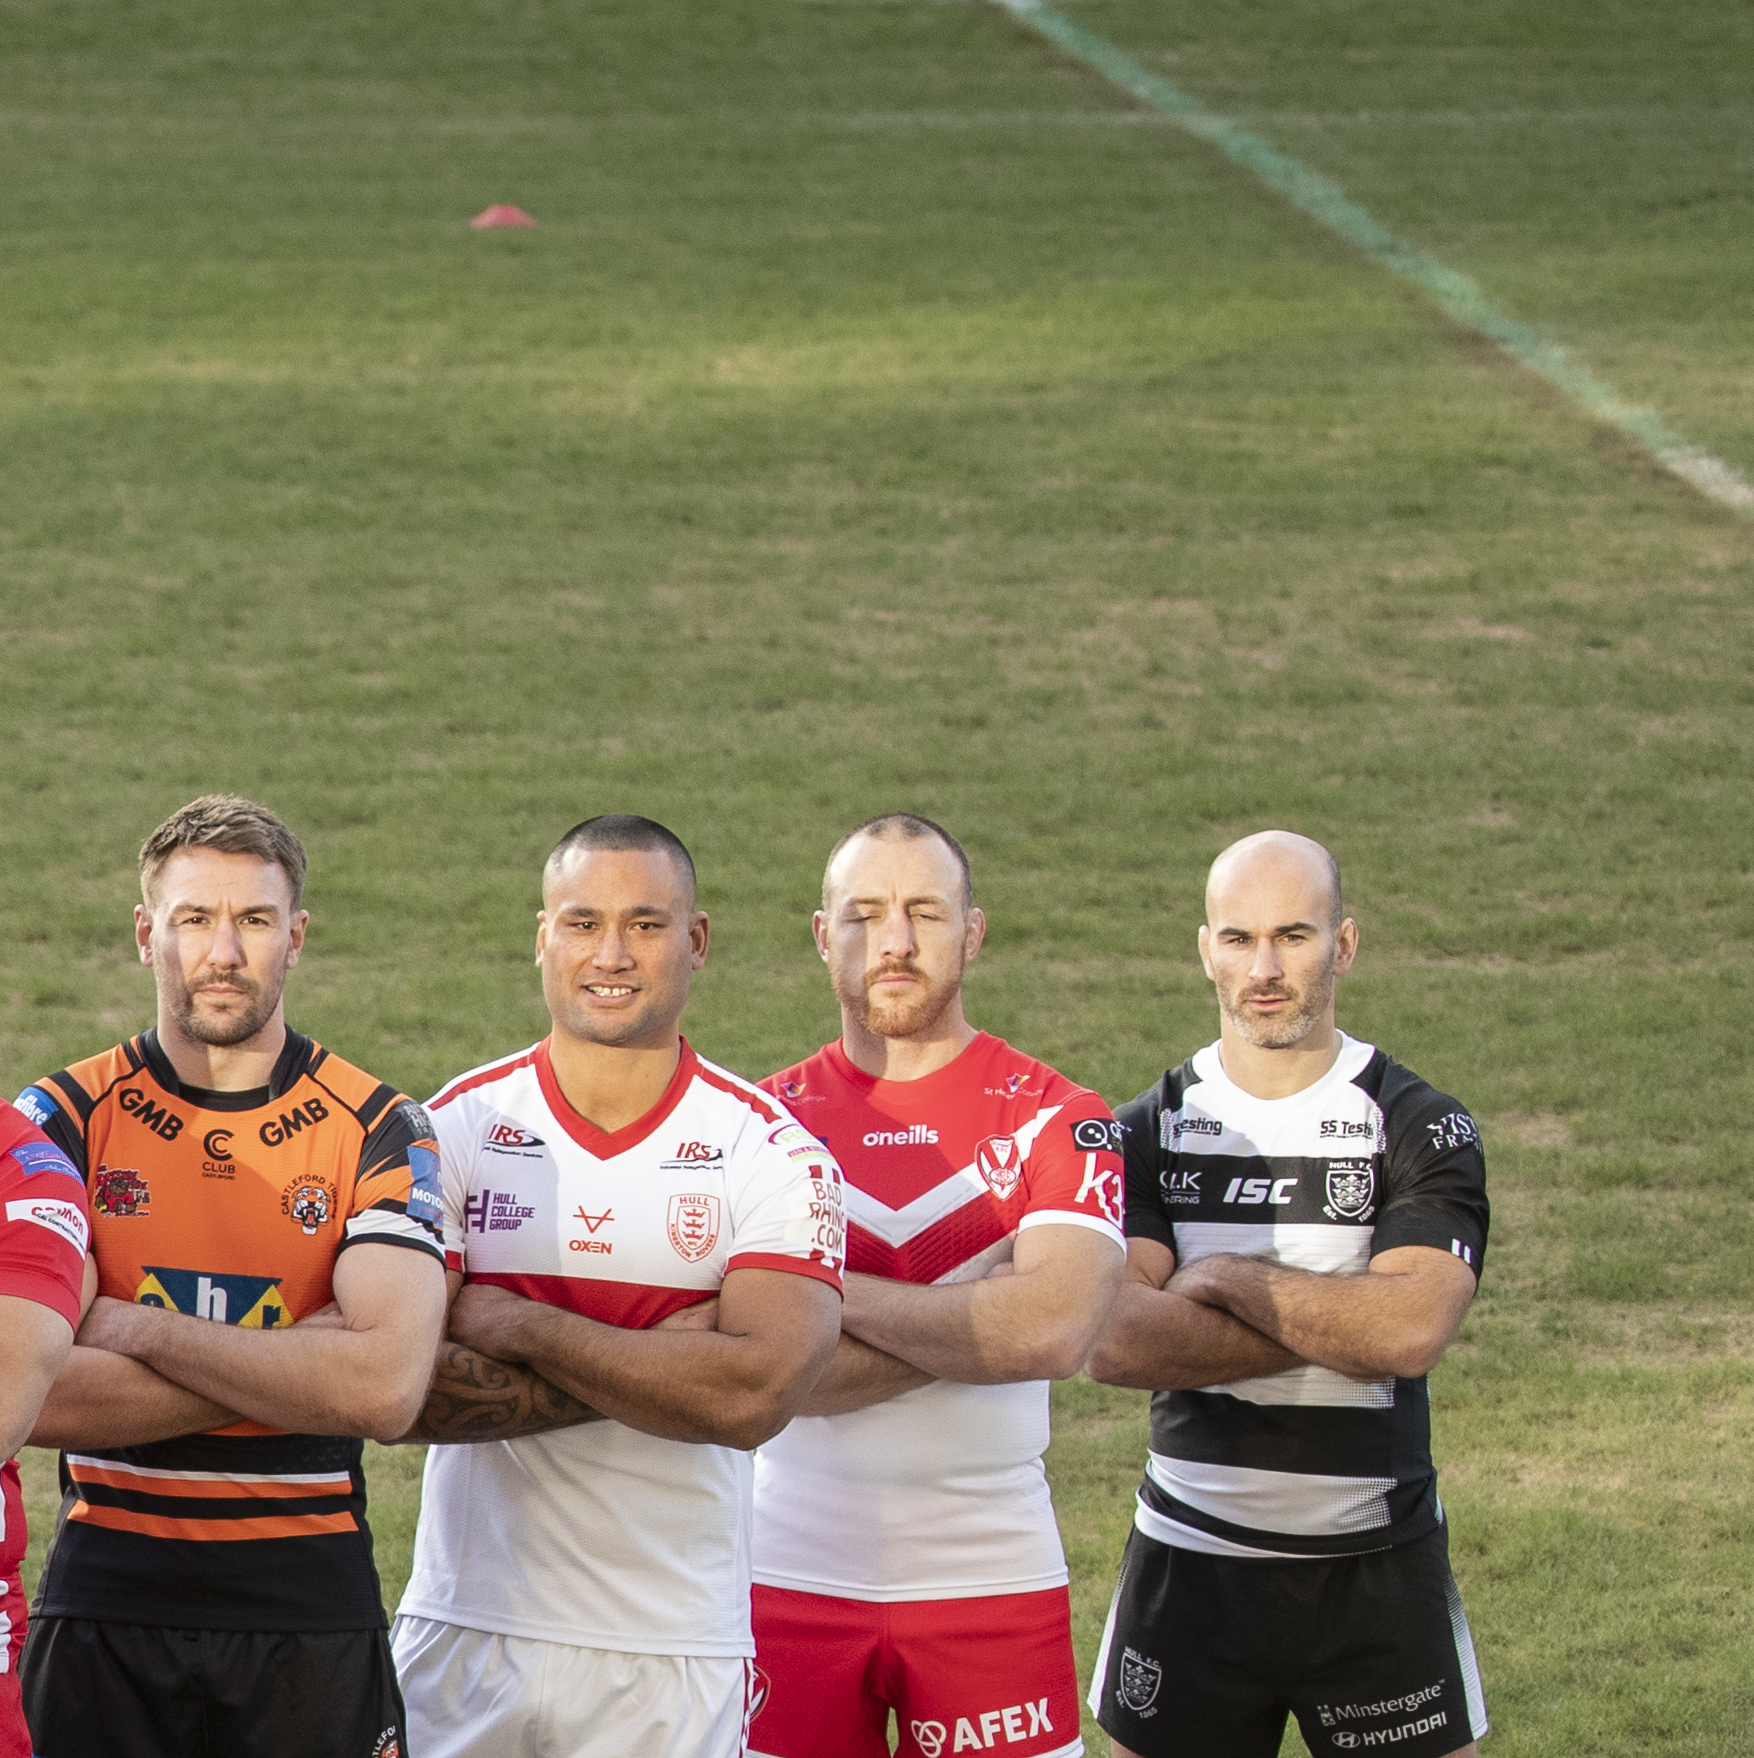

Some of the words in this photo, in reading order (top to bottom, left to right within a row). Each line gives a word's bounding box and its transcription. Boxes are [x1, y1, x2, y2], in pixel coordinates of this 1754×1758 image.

[119, 1088, 184, 1141] GMB
[259, 1097, 330, 1148] GMB
[488, 1123, 526, 1146] IRS
[676, 1141, 712, 1159] IRS
[202, 1161, 236, 1175] CLUB
[1329, 1161, 1354, 1169] HULL
[281, 1173, 326, 1216] CASTLEFORD
[492, 1192, 518, 1205] HULL
[679, 1196, 710, 1207] HULL
[812, 1180, 842, 1207] BAD
[1222, 1177, 1299, 1205] ISC
[491, 1205, 536, 1219] COLLEGE
[489, 1218, 522, 1231] GROUP
[569, 1239, 613, 1255] OXEN
[1335, 1681, 1442, 1722] Minstergate
[953, 1697, 1054, 1754] AFEX
[1363, 1710, 1448, 1747] HYUNDAI
